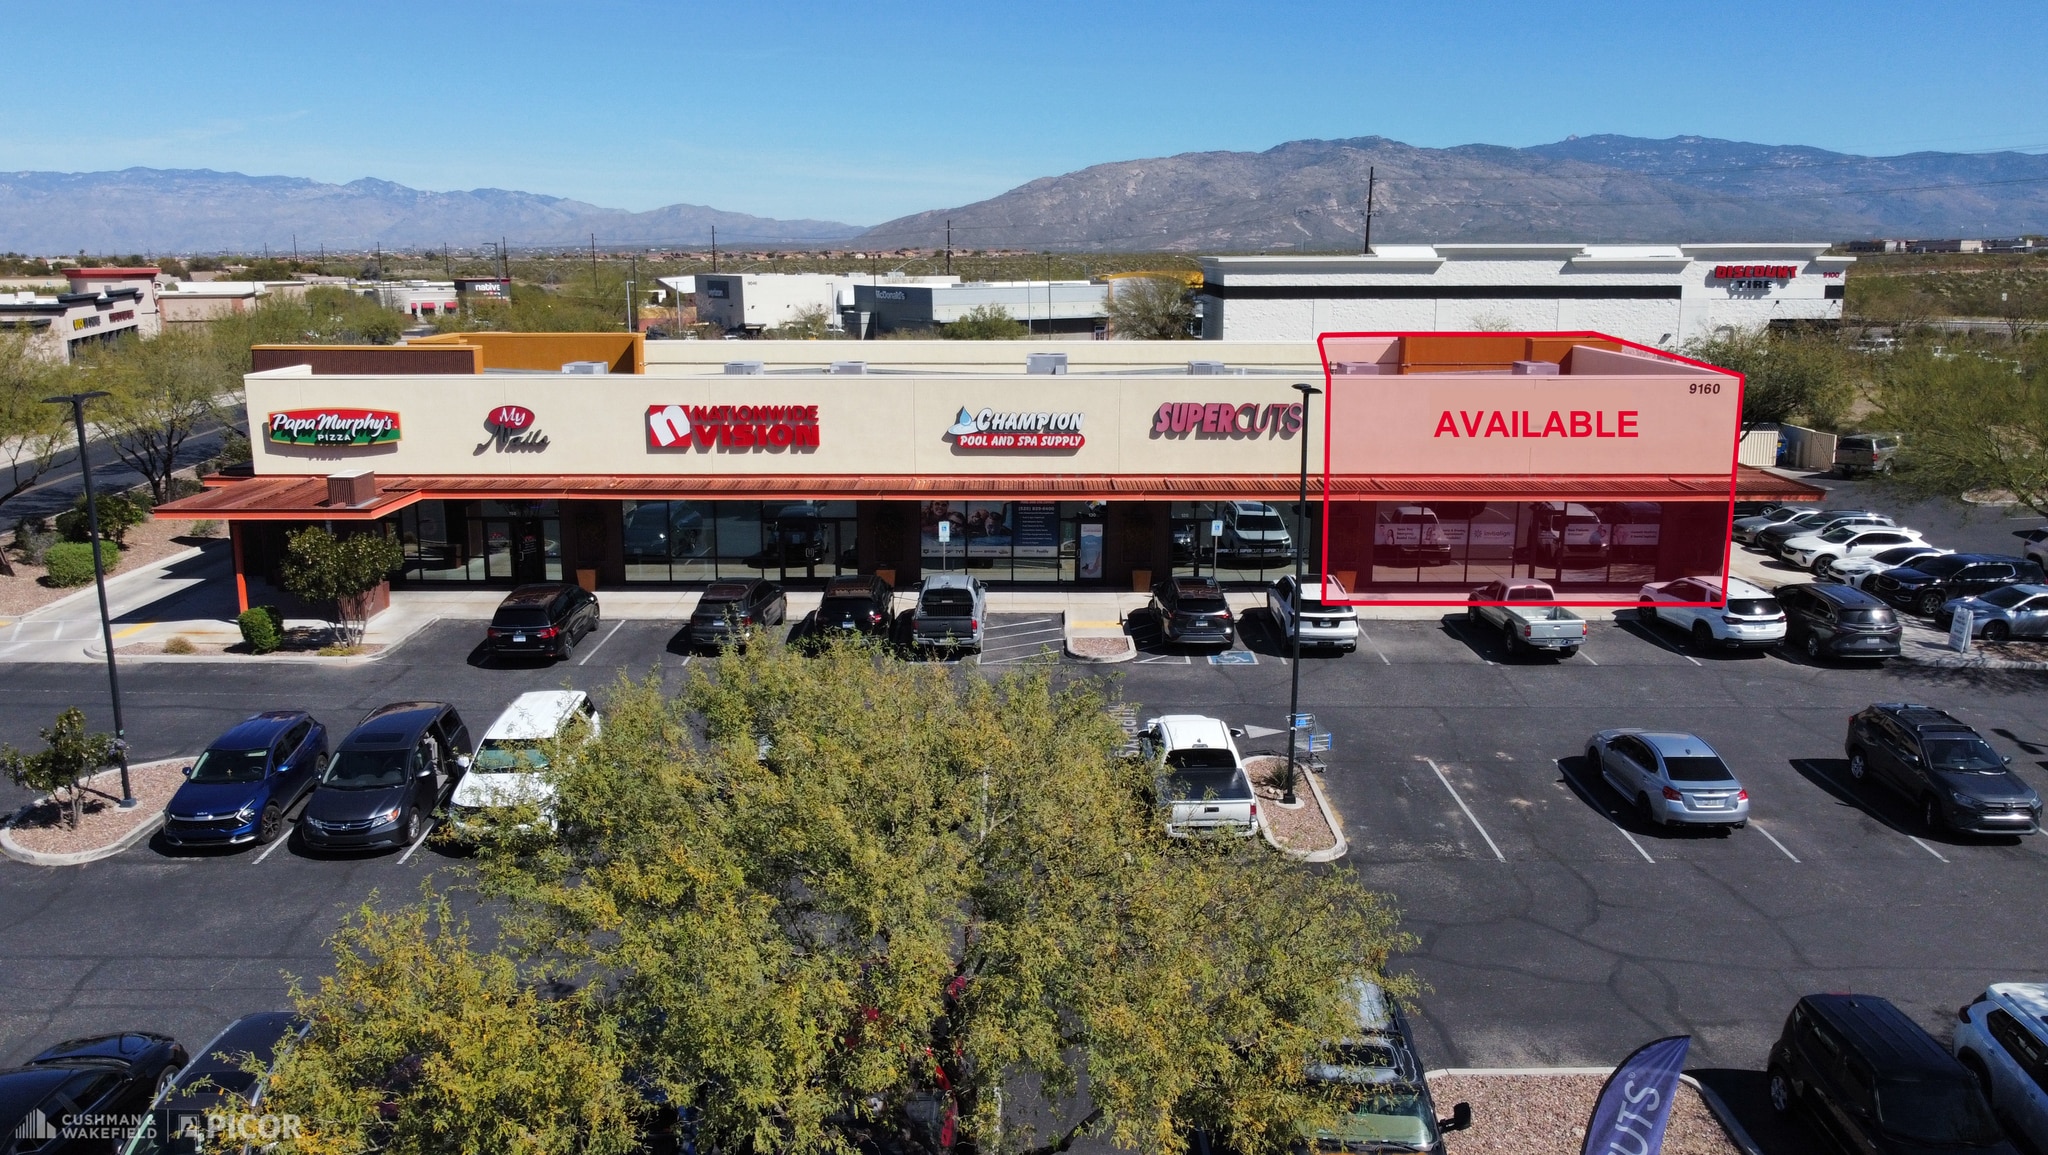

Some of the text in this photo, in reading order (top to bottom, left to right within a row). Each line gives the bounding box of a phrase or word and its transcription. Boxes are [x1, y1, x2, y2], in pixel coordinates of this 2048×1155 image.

[1715, 265, 1797, 279] DISCOUNT
[1737, 280, 1773, 289] TIRE
[1688, 383, 1721, 395] 9160
[499, 407, 526, 426] My
[693, 405, 819, 422] NATIONWIDE
[976, 407, 1085, 431] CHAMPION
[1155, 402, 1304, 433] SUPERCUTS
[272, 412, 393, 437] Papa Murphy's
[317, 433, 352, 441] PIZZA
[474, 424, 550, 454] Nails
[694, 424, 821, 447] VISION
[960, 435, 1082, 446] POOL AND SPA SUPPLY
[1608, 1080, 1660, 1155] UTS
